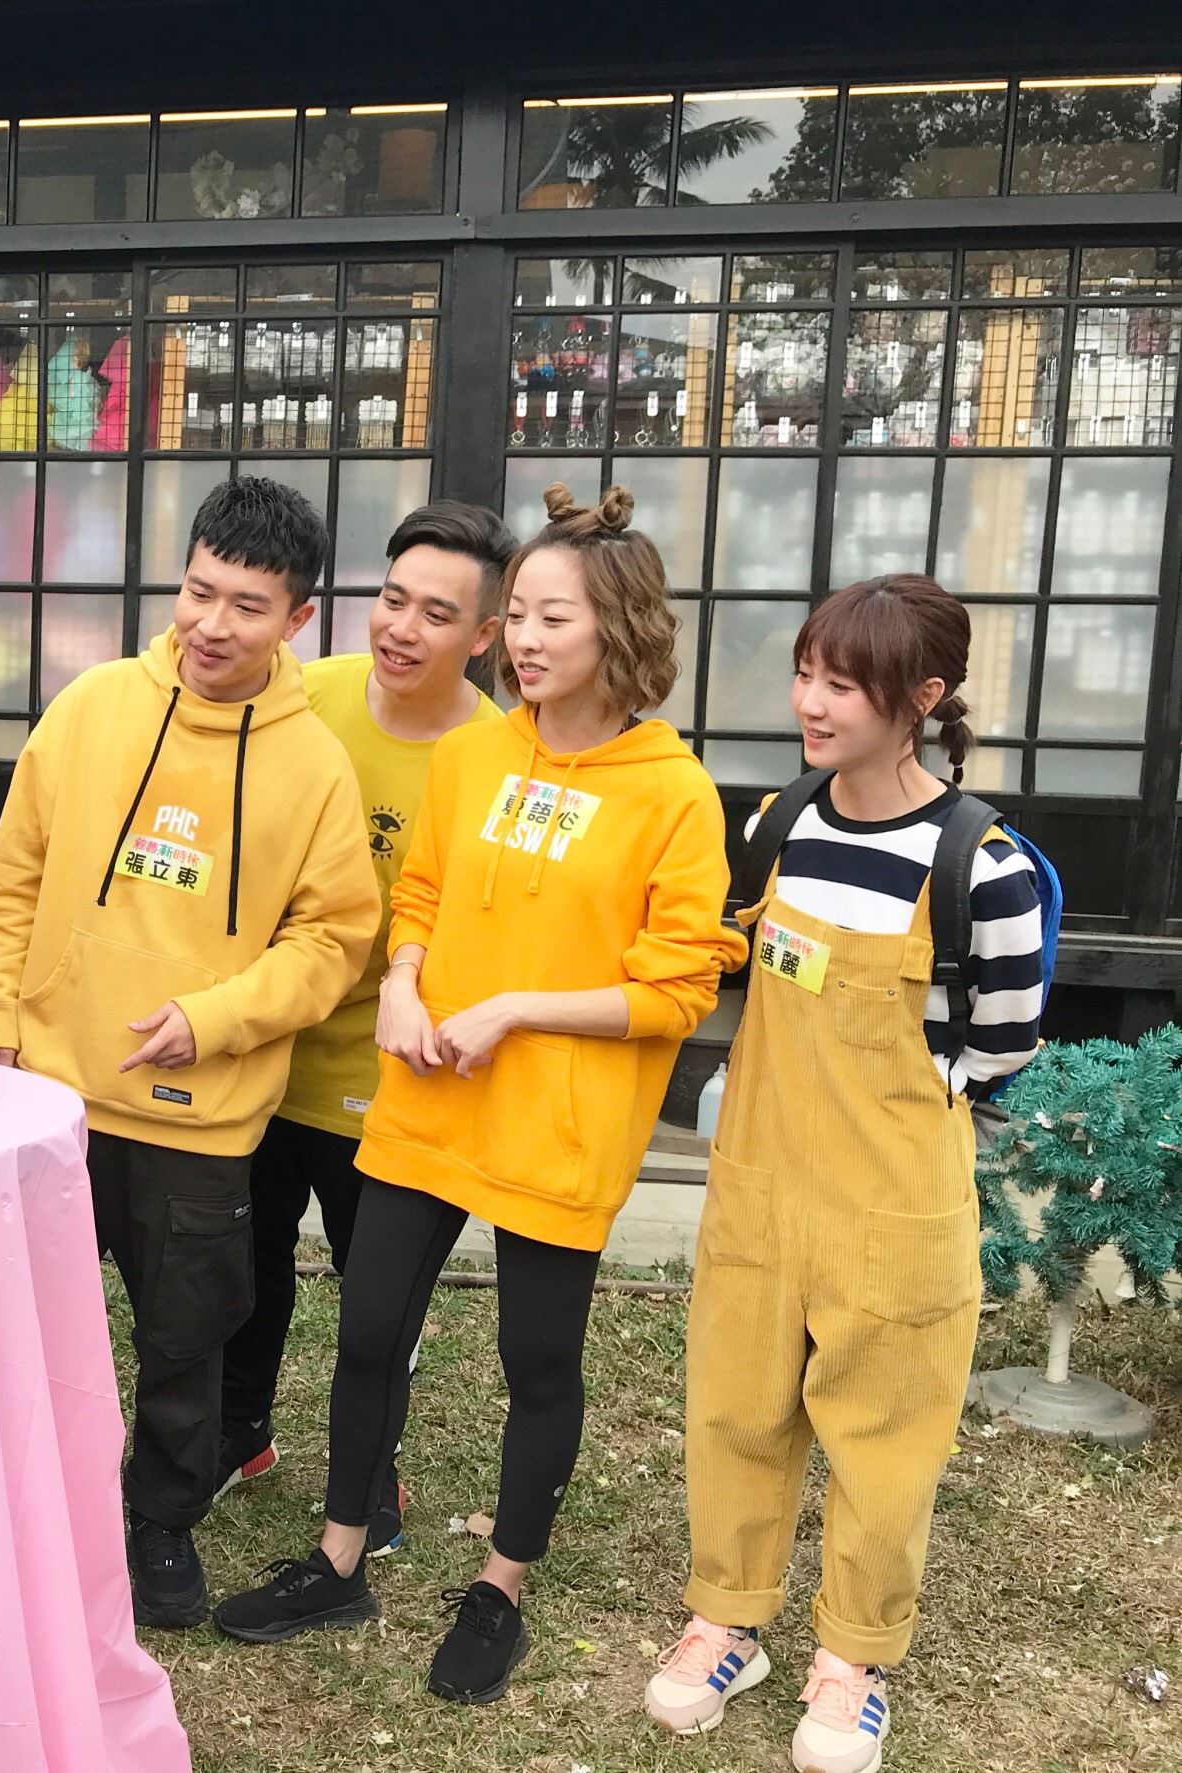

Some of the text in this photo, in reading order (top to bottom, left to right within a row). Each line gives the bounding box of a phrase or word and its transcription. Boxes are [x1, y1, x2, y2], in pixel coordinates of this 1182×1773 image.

[153, 804, 200, 842] PHC
[125, 851, 200, 890] 張立東
[759, 941, 801, 979] 瑪麗
